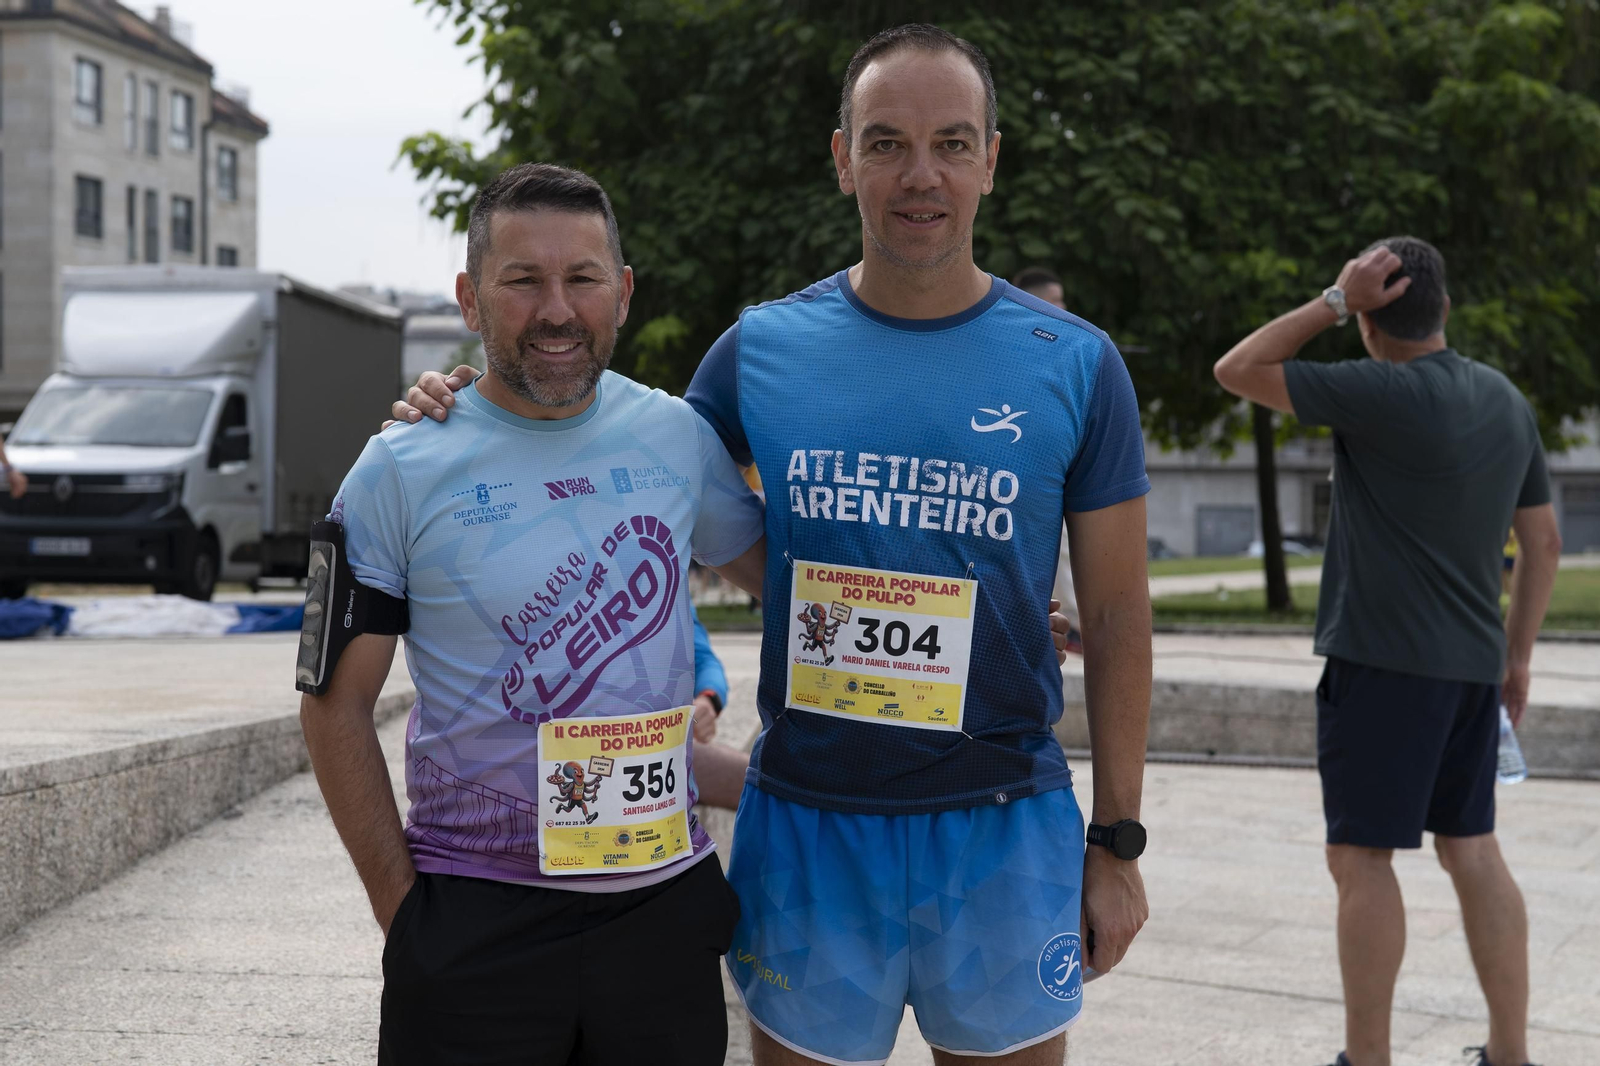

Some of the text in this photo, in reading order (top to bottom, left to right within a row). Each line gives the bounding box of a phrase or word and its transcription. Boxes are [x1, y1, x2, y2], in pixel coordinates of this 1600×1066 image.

[632, 465, 669, 478] XUNTA
[786, 449, 1019, 505] ATLETISMO
[565, 476, 590, 489] RUN
[634, 475, 690, 490] DE GALICIA
[453, 501, 517, 520] DEPUTACIÓN
[463, 511, 511, 527] OURENSE
[789, 485, 1013, 541] ARENTEIRO
[524, 520, 630, 665] POPULAR DE
[806, 568, 961, 597] II CARREIRA POPULAR
[501, 551, 586, 646] Carreira
[841, 586, 916, 607] DO PULPO
[532, 559, 659, 705] LEIRO
[854, 617, 941, 660] 304
[842, 654, 950, 675] MARIO DANIEL VARELA CRESPO
[834, 698, 855, 706] VITAMIN
[877, 708, 903, 717] NOCCO
[554, 712, 683, 739] II CARREIRA POPULAR
[601, 732, 664, 751] DO PULPO
[622, 758, 675, 802] 356
[623, 804, 654, 816] SANTIAGO
[655, 800, 668, 811] LAMAS
